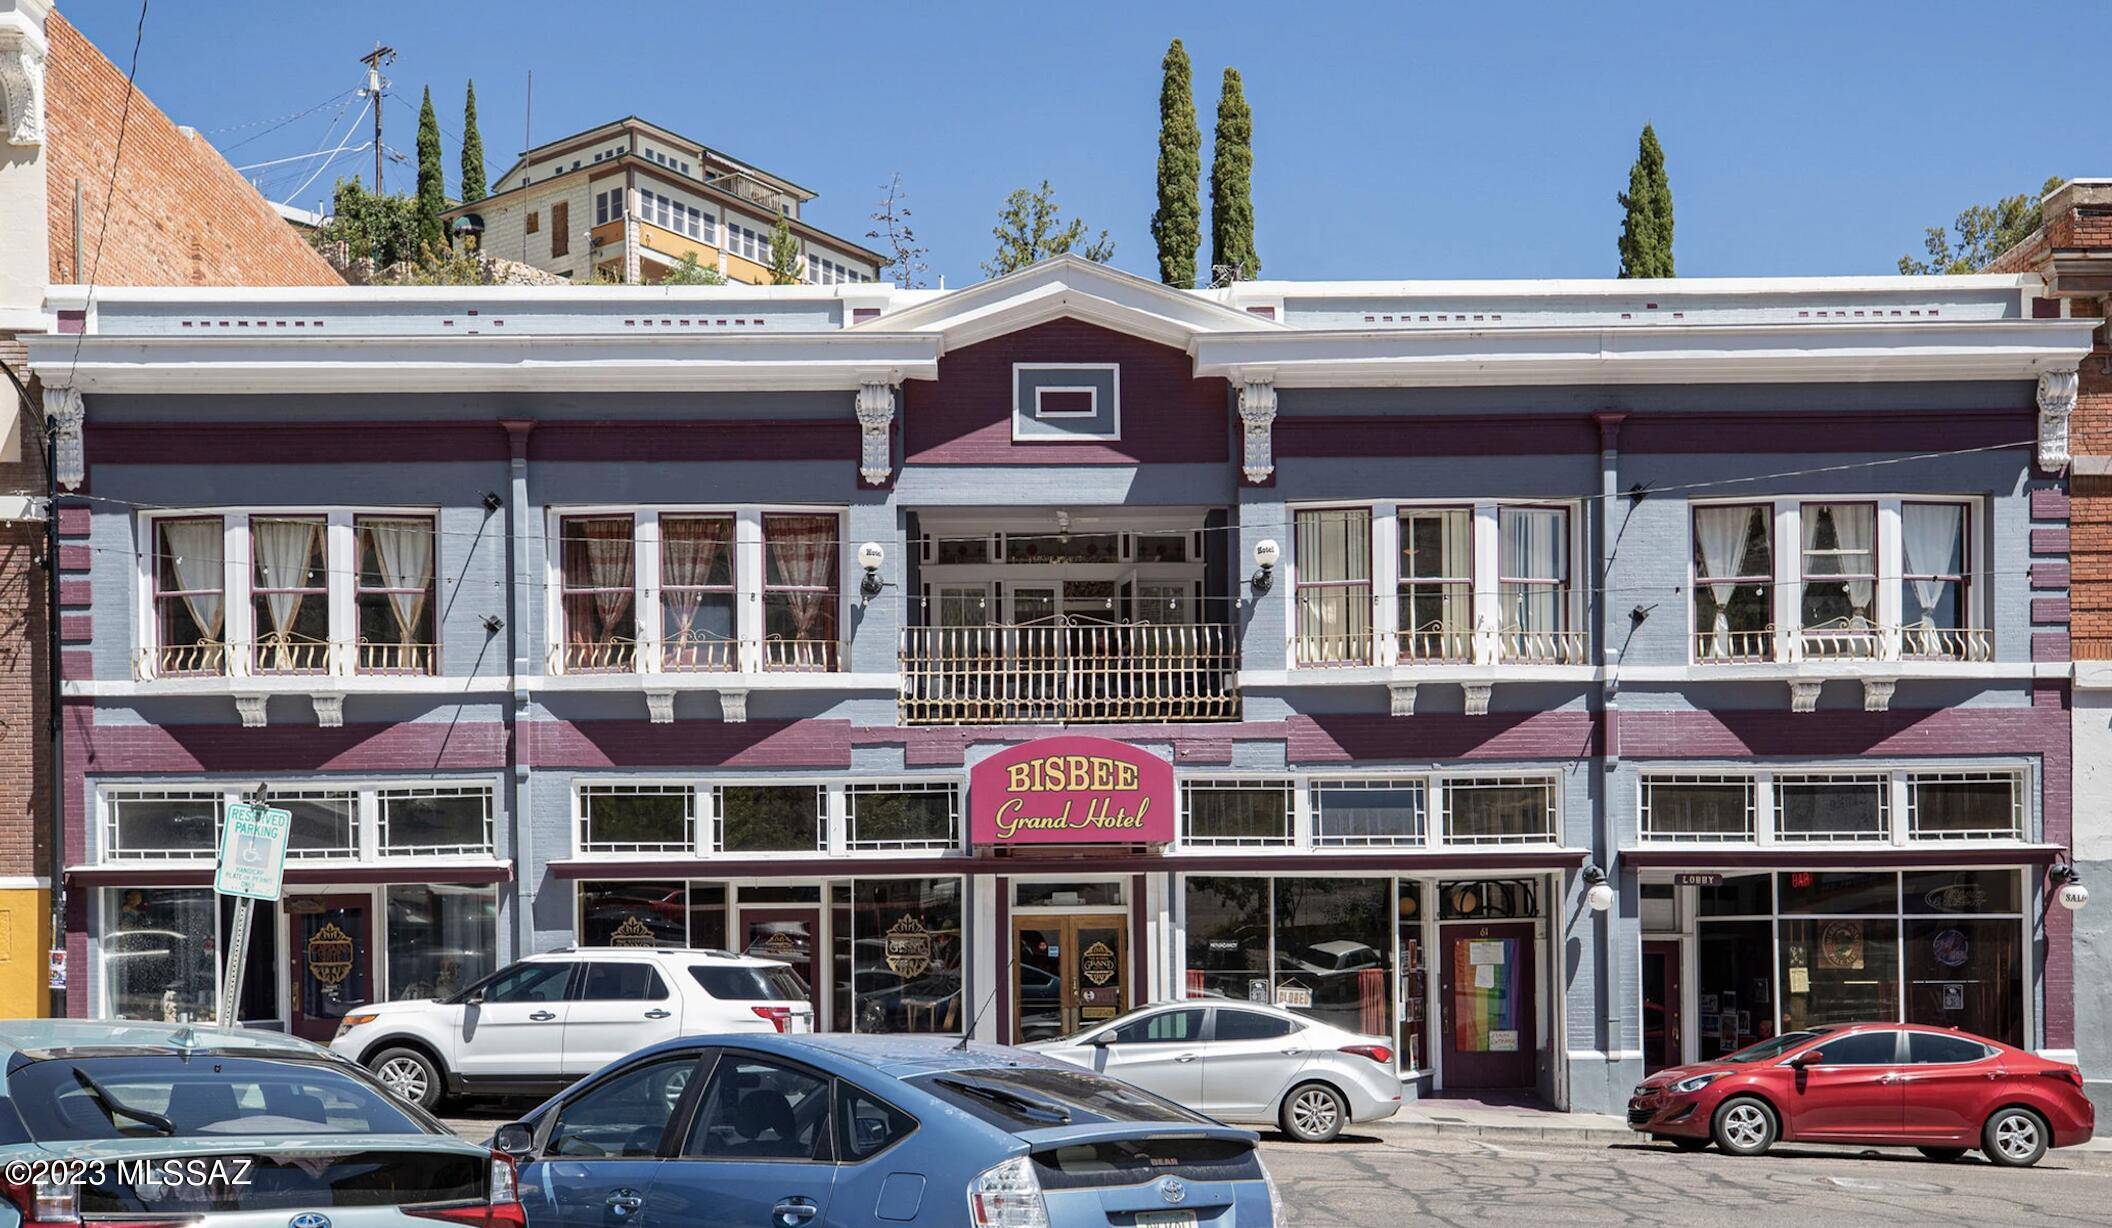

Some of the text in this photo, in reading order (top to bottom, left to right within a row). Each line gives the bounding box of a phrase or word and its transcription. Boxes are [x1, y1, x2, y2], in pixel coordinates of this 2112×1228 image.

[1006, 756, 1139, 793] BISBEE
[995, 796, 1151, 839] Grand Hotel
[234, 821, 279, 840] PARKING
[1682, 875, 1714, 885] LOBBY
[1792, 872, 1810, 888] BAR
[1479, 927, 1489, 937] 61
[1083, 960, 1115, 971] GRAND
[1279, 991, 1310, 1006] CLOSED
